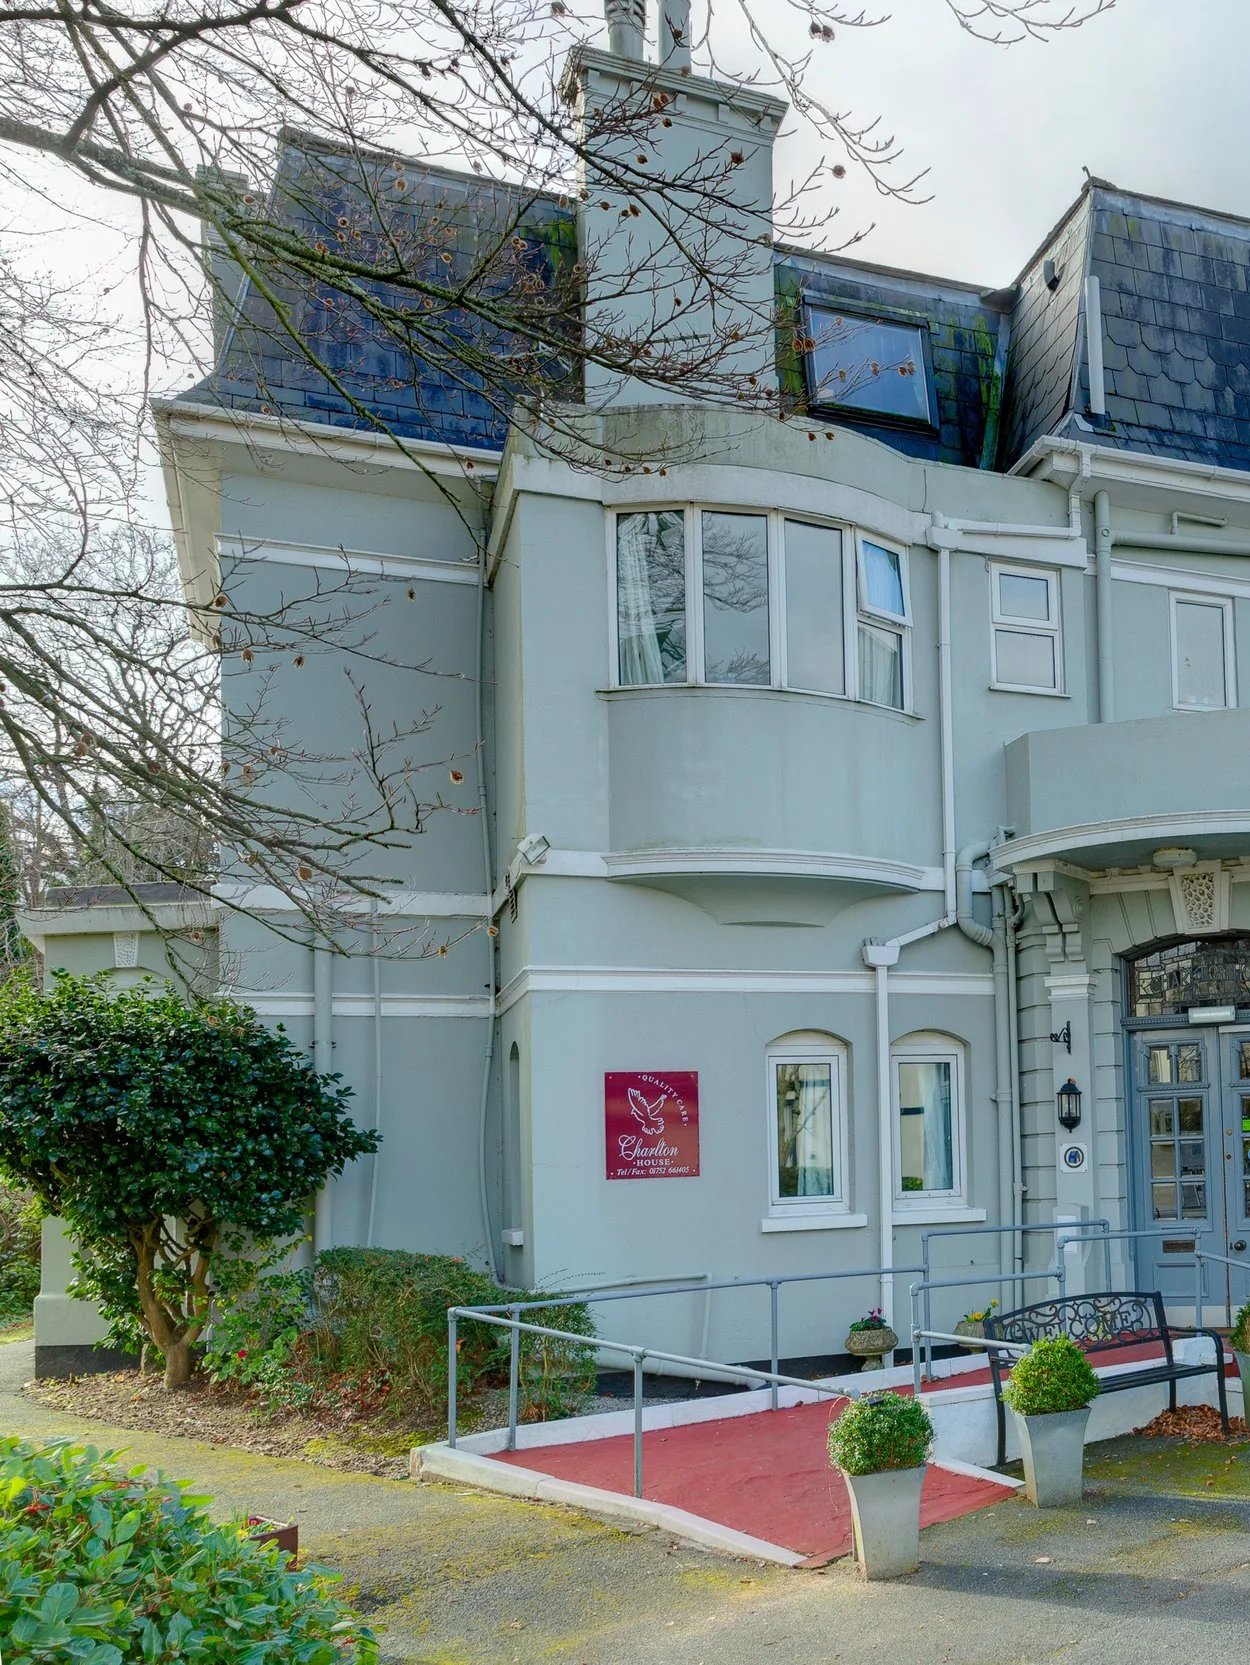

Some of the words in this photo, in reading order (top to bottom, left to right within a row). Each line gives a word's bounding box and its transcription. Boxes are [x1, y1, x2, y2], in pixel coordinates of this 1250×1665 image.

[641, 1074, 678, 1098] QUALITY
[676, 1099, 689, 1122] CARE
[618, 1134, 679, 1160] Charlton
